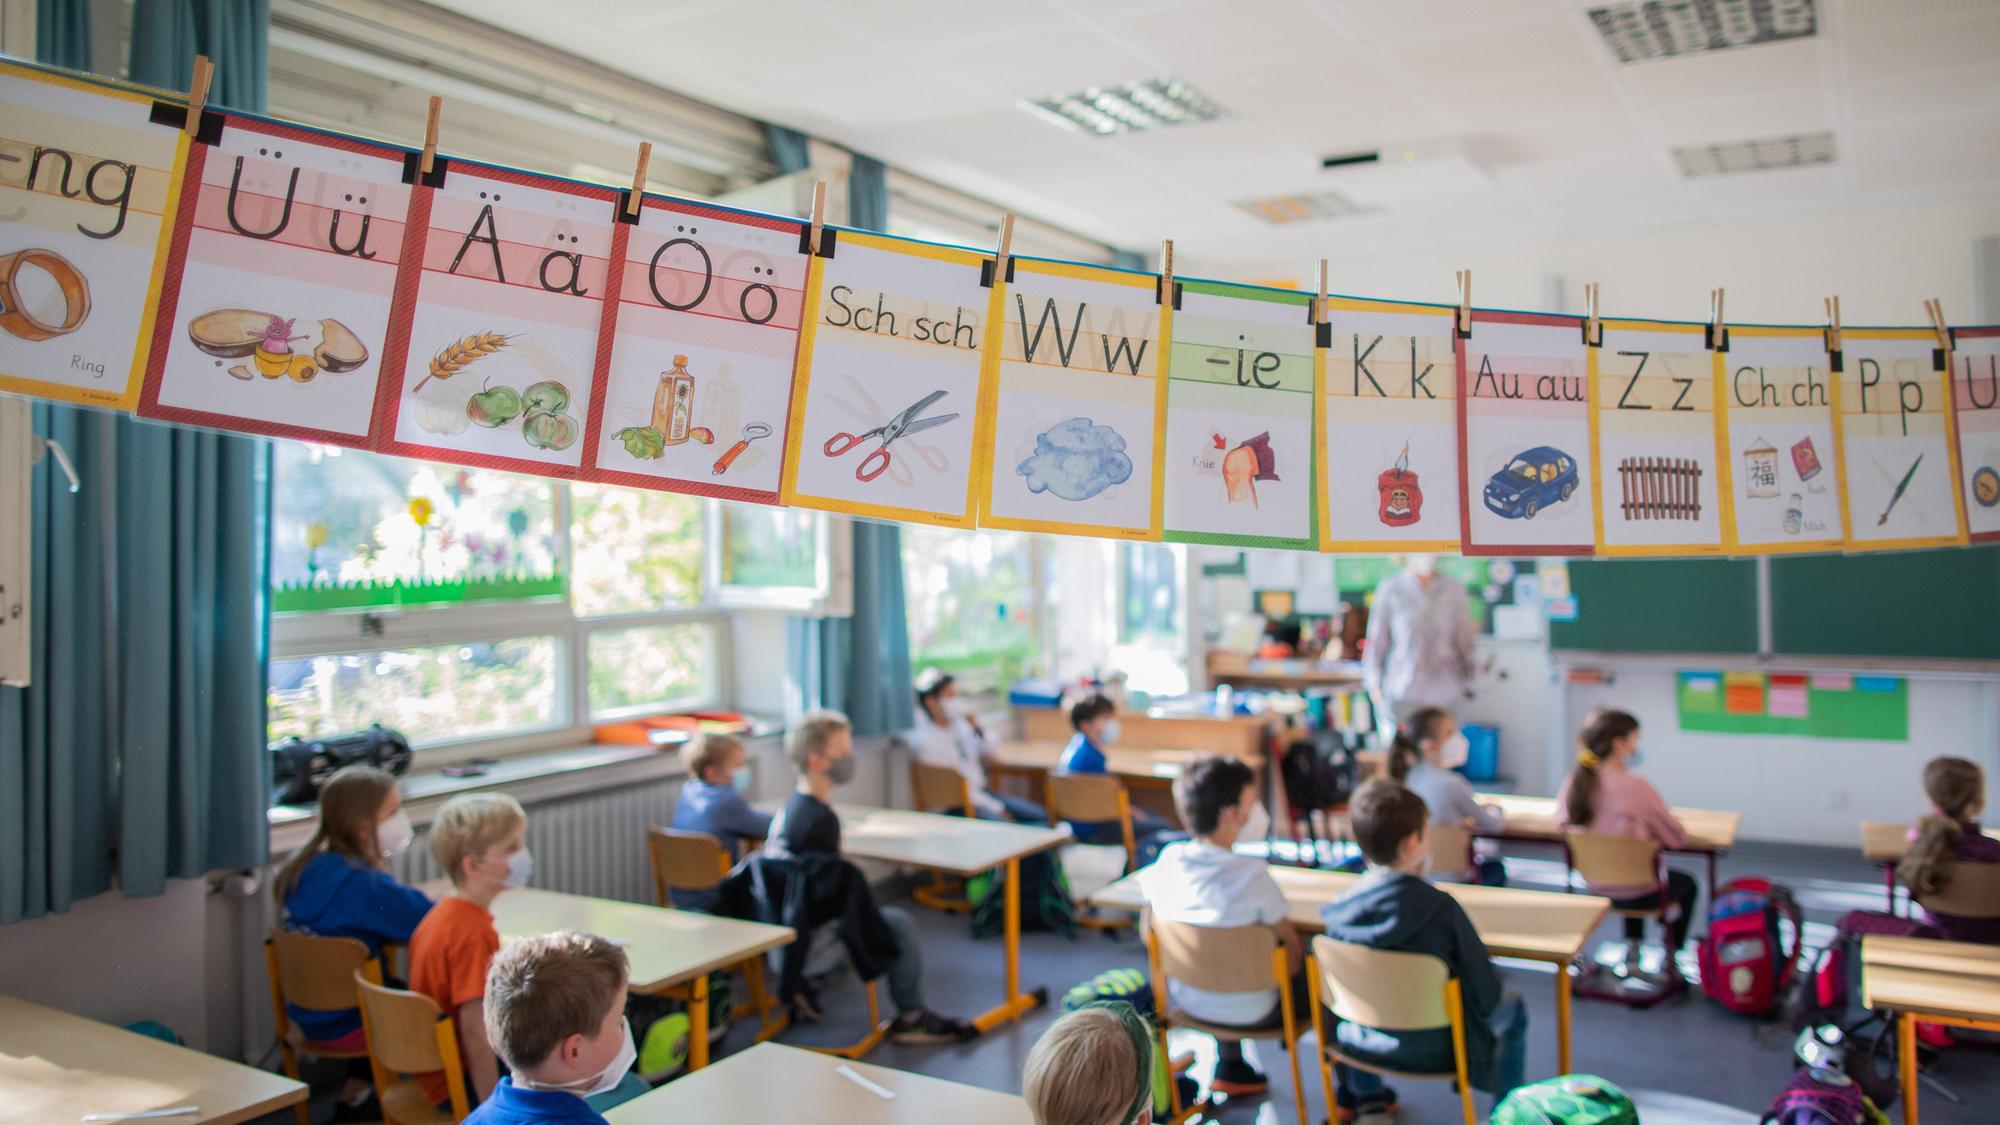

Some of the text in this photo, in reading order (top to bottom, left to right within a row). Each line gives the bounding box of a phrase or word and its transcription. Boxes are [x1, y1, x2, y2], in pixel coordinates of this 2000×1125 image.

[227, 147, 376, 260] Ü ü
[448, 191, 588, 297] Ä ä
[648, 224, 778, 325] Ö ö
[825, 285, 977, 349] Sch sch
[1016, 293, 1148, 376] W w
[71, 354, 105, 379] Ring
[1205, 334, 1281, 389] -ie
[1354, 333, 1436, 399] K k
[1473, 354, 1585, 401] Au au
[1617, 351, 1695, 411] Z z
[1733, 366, 1828, 407] Ch ch
[1966, 354, 1998, 410] U
[1858, 357, 1923, 436] P p
[1192, 455, 1216, 469] Knie
[1750, 460, 1775, 489] 福
